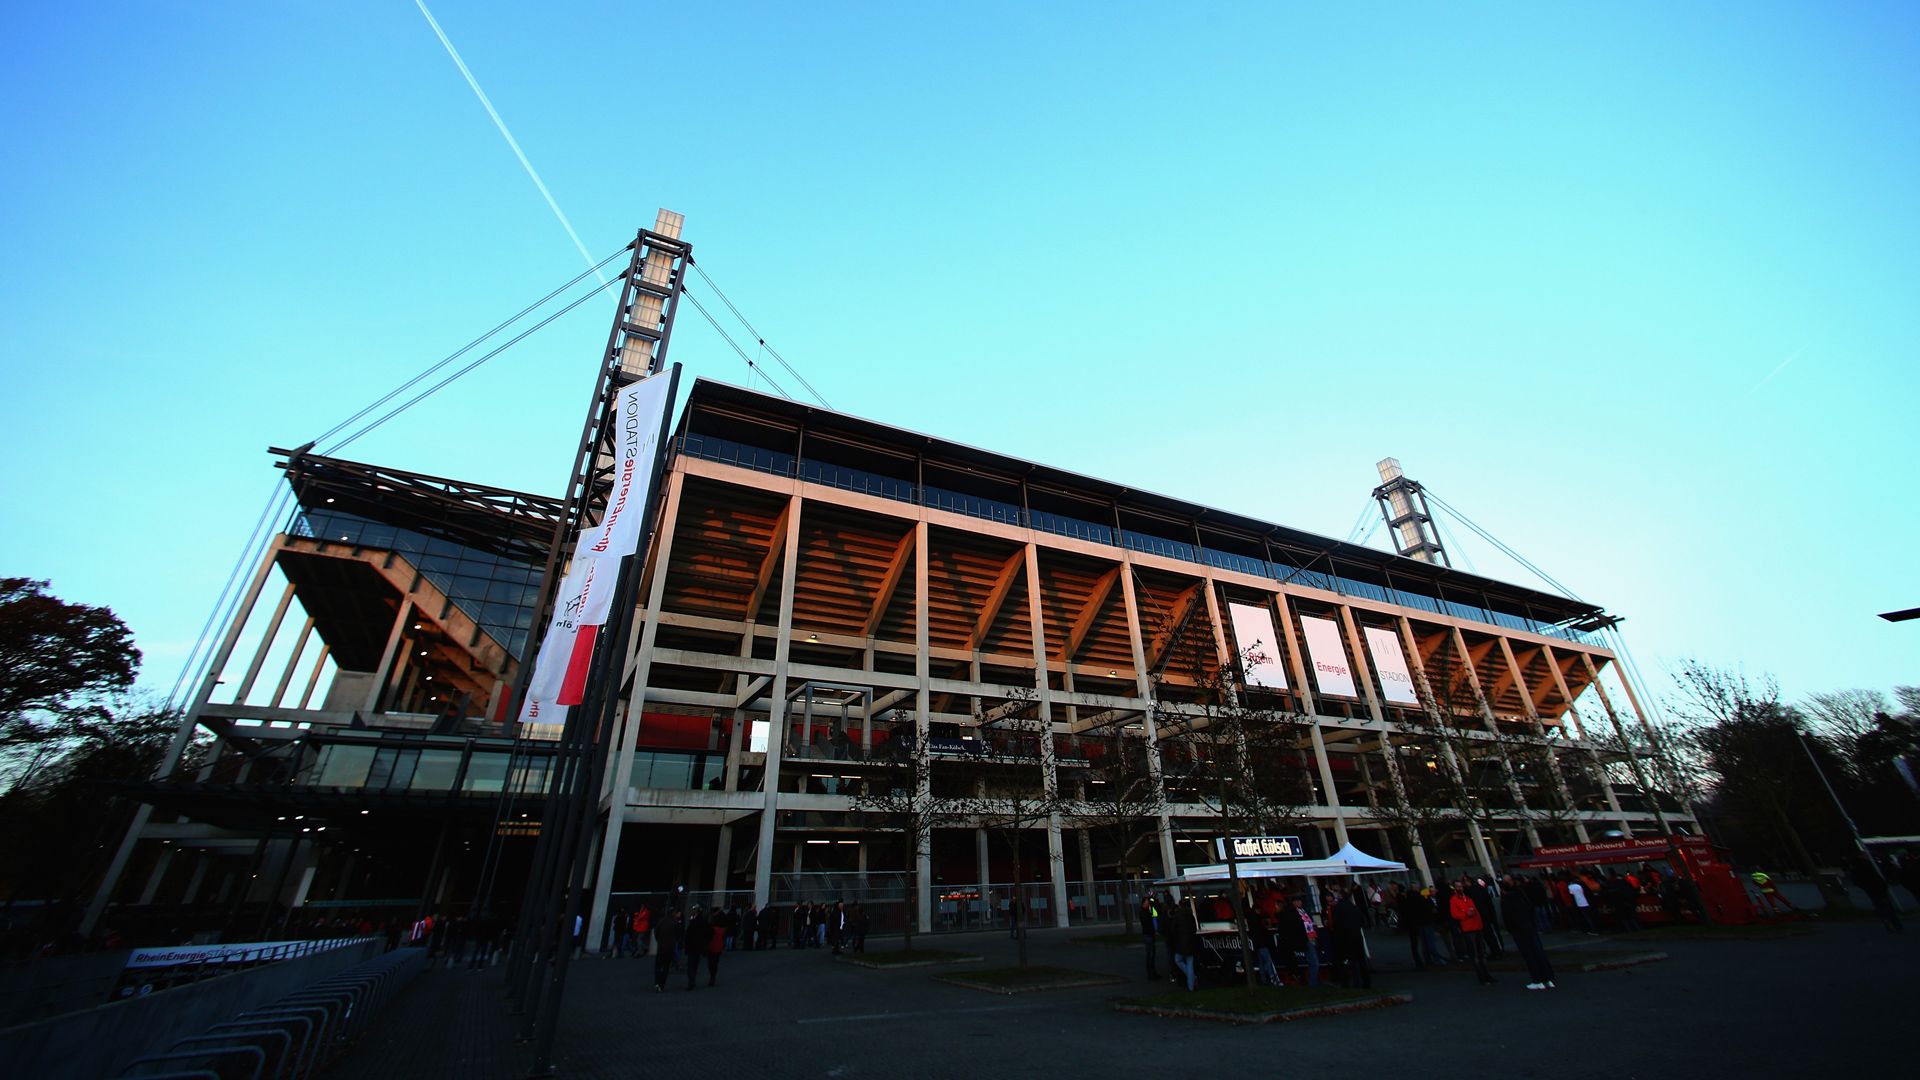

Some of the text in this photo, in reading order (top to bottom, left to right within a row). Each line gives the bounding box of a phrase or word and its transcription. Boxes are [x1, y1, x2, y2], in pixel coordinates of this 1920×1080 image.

[1316, 661, 1347, 676] Energie
[1379, 670, 1411, 684] STADION
[1234, 838, 1292, 856] Gaffel Kölsch
